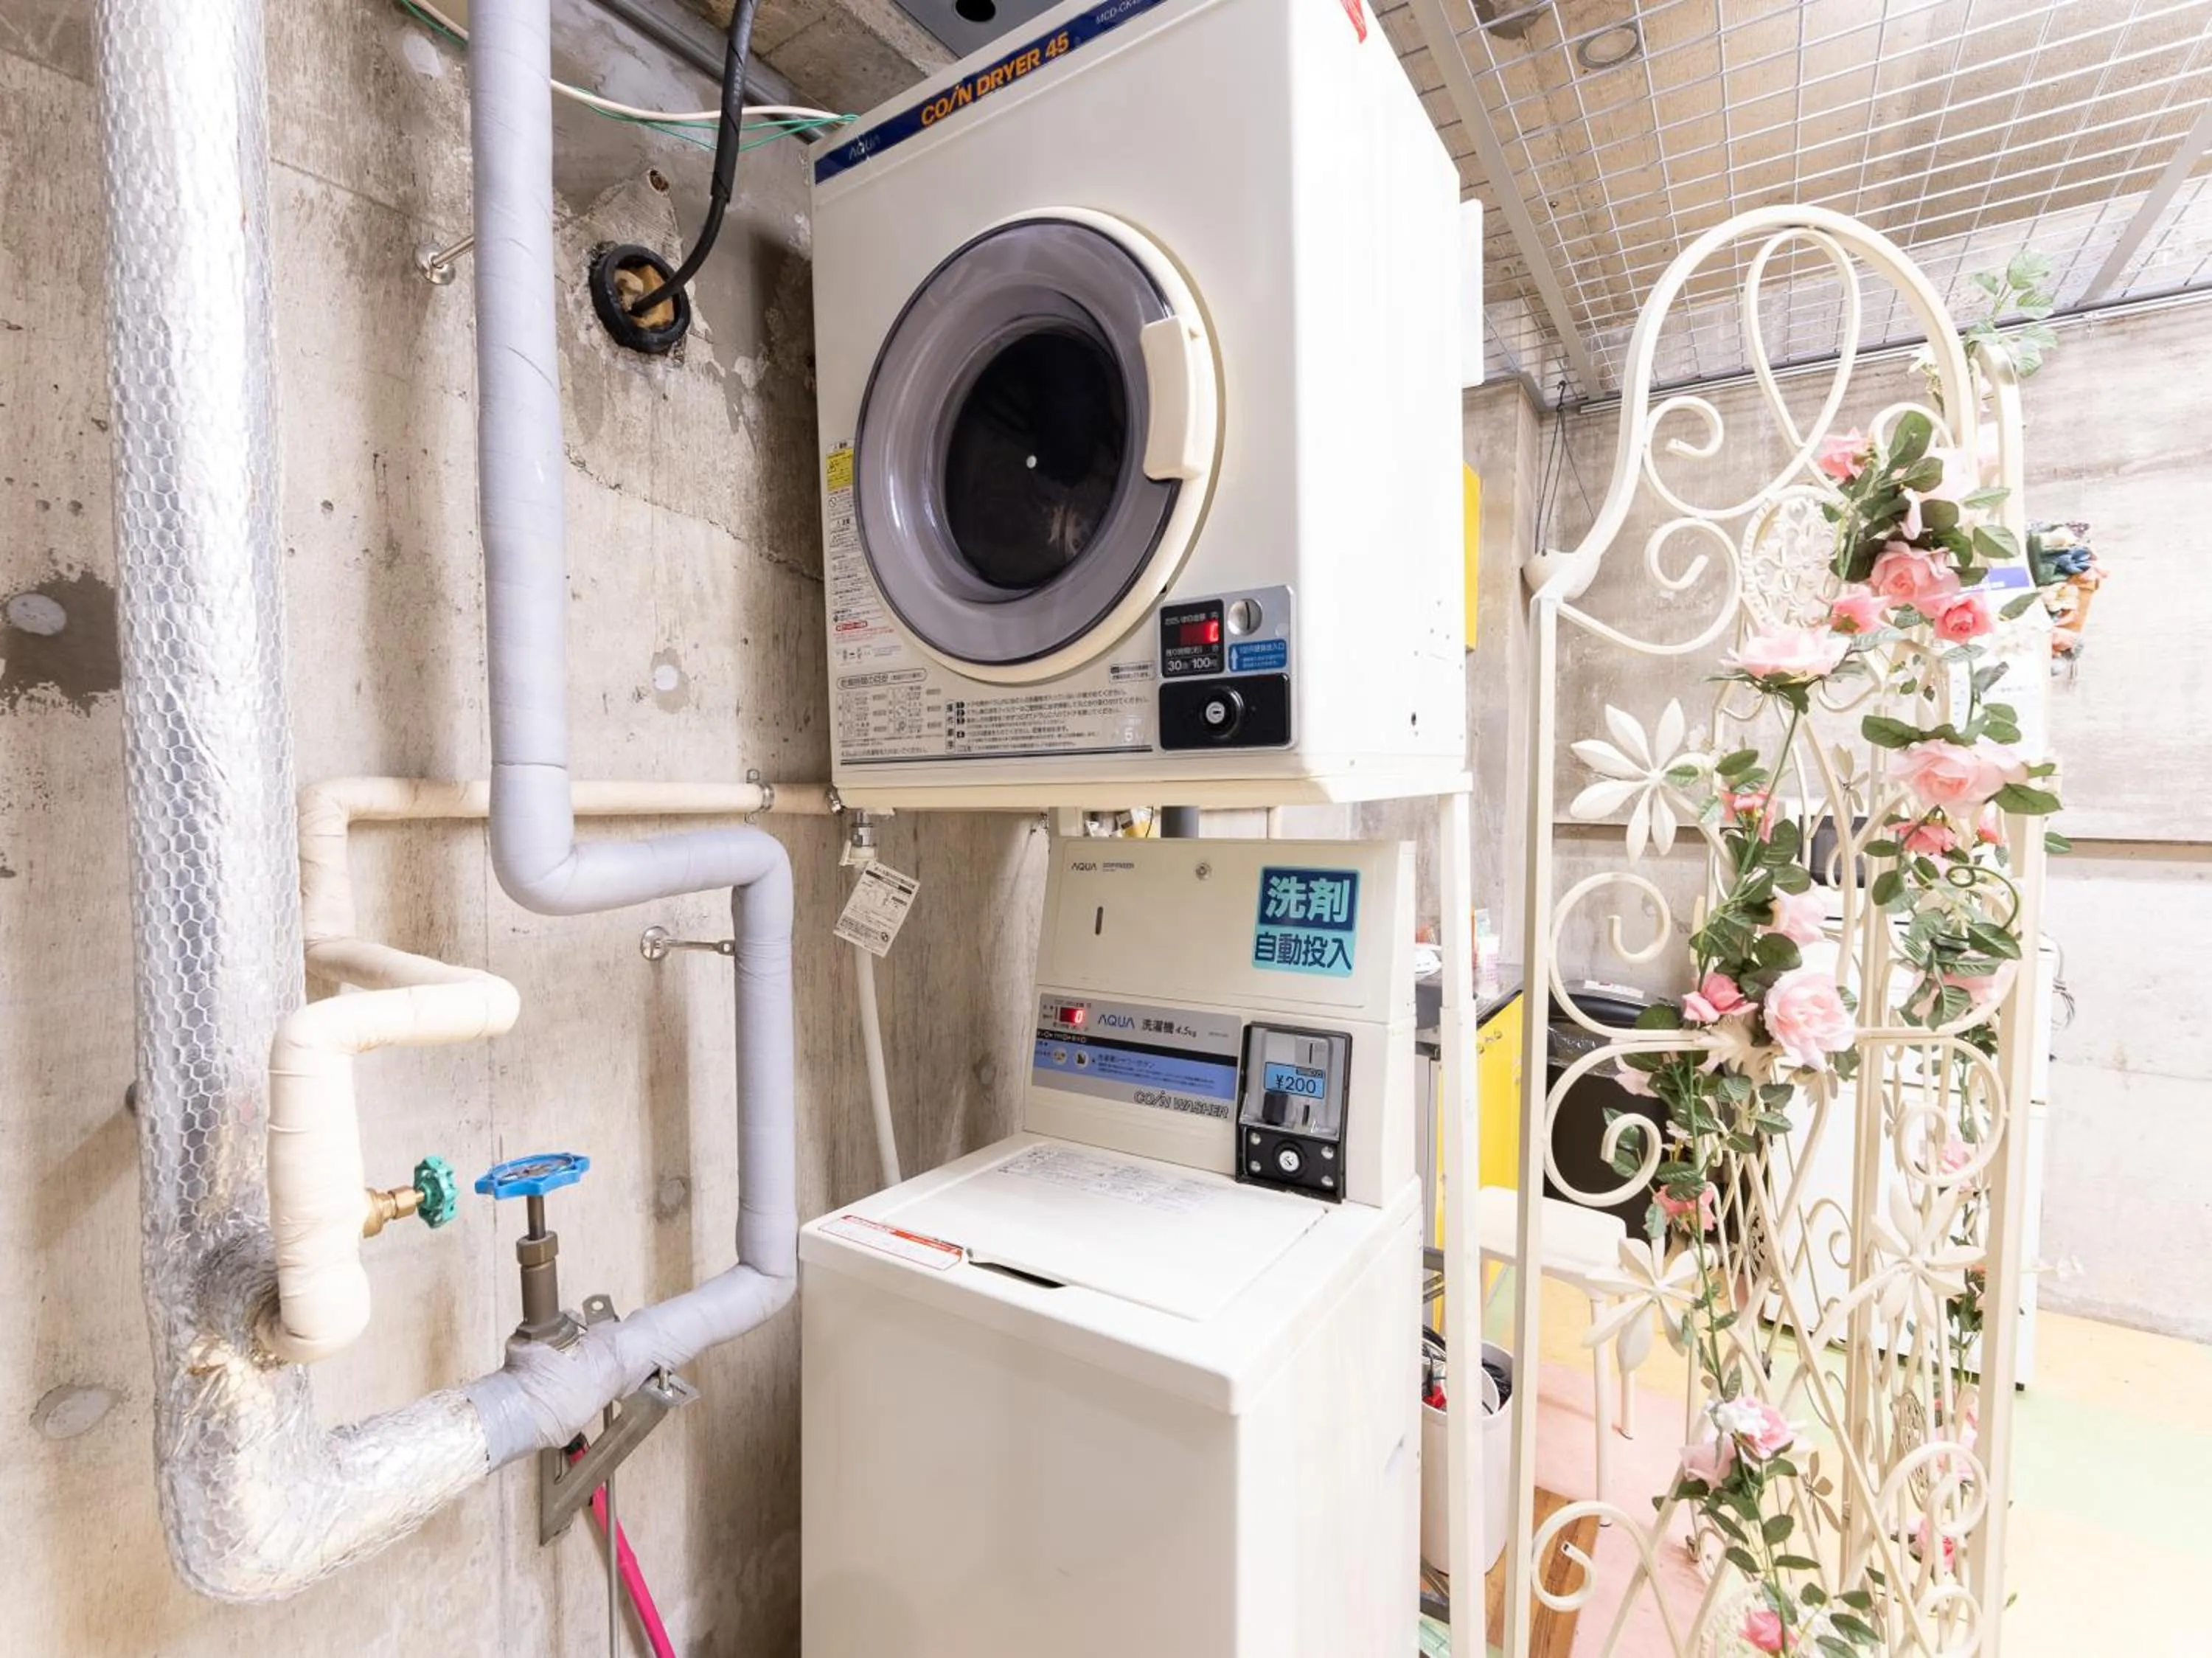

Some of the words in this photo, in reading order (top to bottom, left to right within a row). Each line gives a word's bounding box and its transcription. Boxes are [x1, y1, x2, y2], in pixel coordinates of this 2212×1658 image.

[922, 82, 973, 125] COIN
[977, 48, 1041, 96] DRYER
[1046, 32, 1069, 58] 45
[1071, 862, 1098, 871] AQUA
[1265, 875, 1350, 923] 洗剤
[1254, 932, 1352, 971] 自動投入
[1074, 1010, 1084, 1024] 0
[1097, 1013, 1135, 1030] AQUA
[1141, 1019, 1175, 1035] 洗濯機
[1276, 1073, 1316, 1094] ¥200
[1133, 1090, 1172, 1109] COIN
[1173, 1097, 1229, 1119] WASHER
